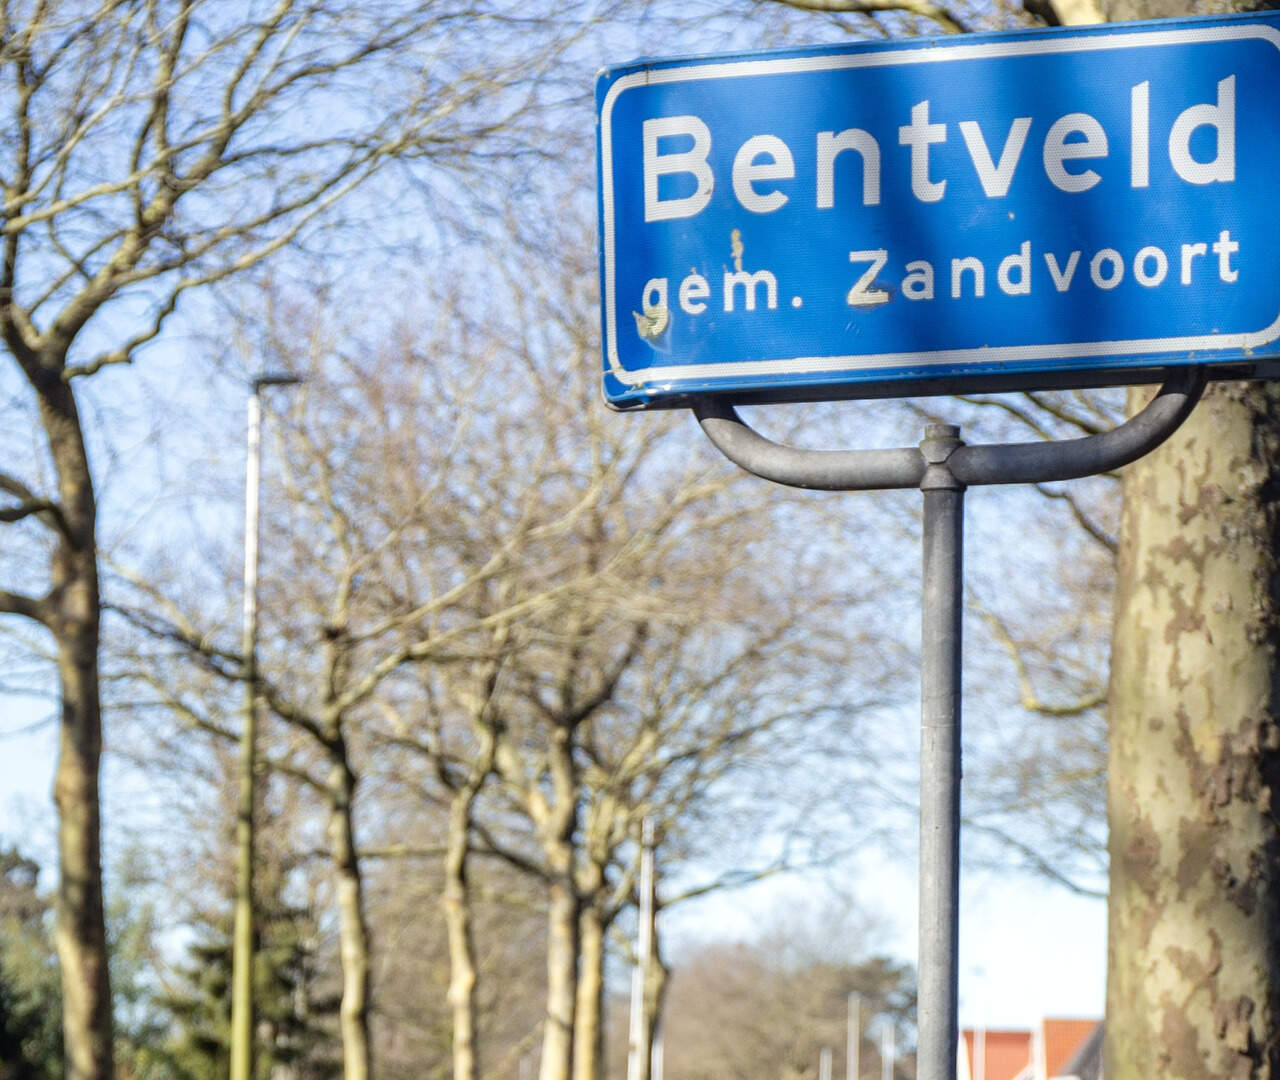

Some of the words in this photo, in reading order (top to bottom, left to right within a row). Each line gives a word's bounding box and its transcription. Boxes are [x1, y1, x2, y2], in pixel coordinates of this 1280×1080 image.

[642, 74, 1237, 223] Bentveld
[639, 268, 803, 338] gem.
[847, 230, 1239, 307] Zandvoort
